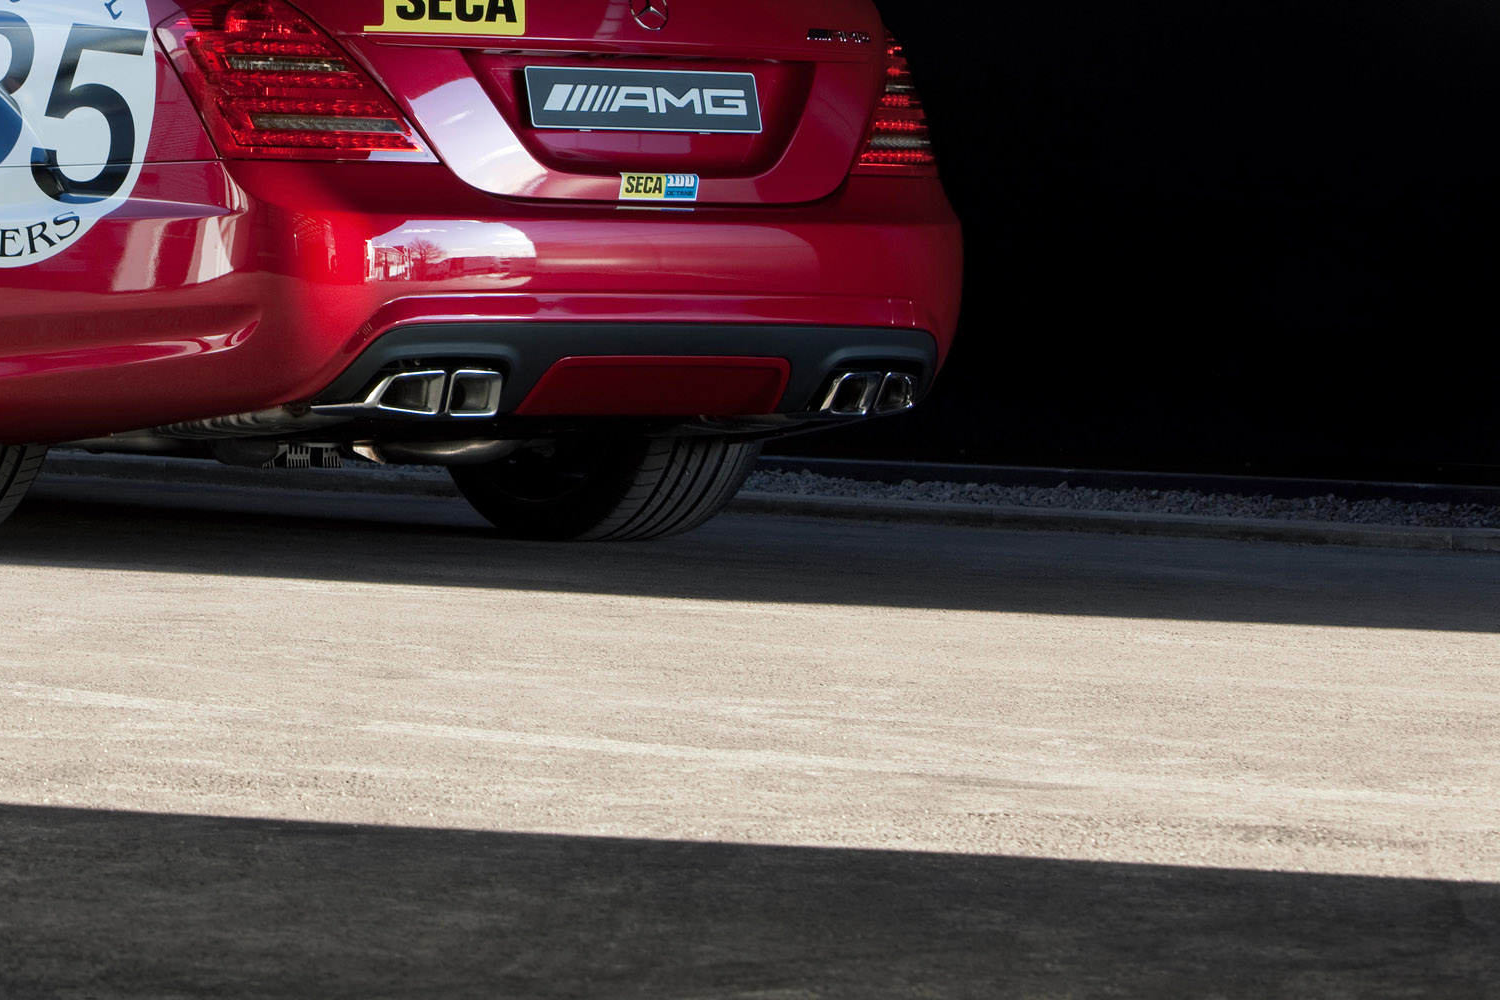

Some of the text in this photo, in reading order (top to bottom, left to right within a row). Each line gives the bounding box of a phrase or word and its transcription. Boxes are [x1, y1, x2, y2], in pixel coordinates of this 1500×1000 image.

[609, 86, 748, 115] AMG
[625, 175, 695, 194] SECA 100
